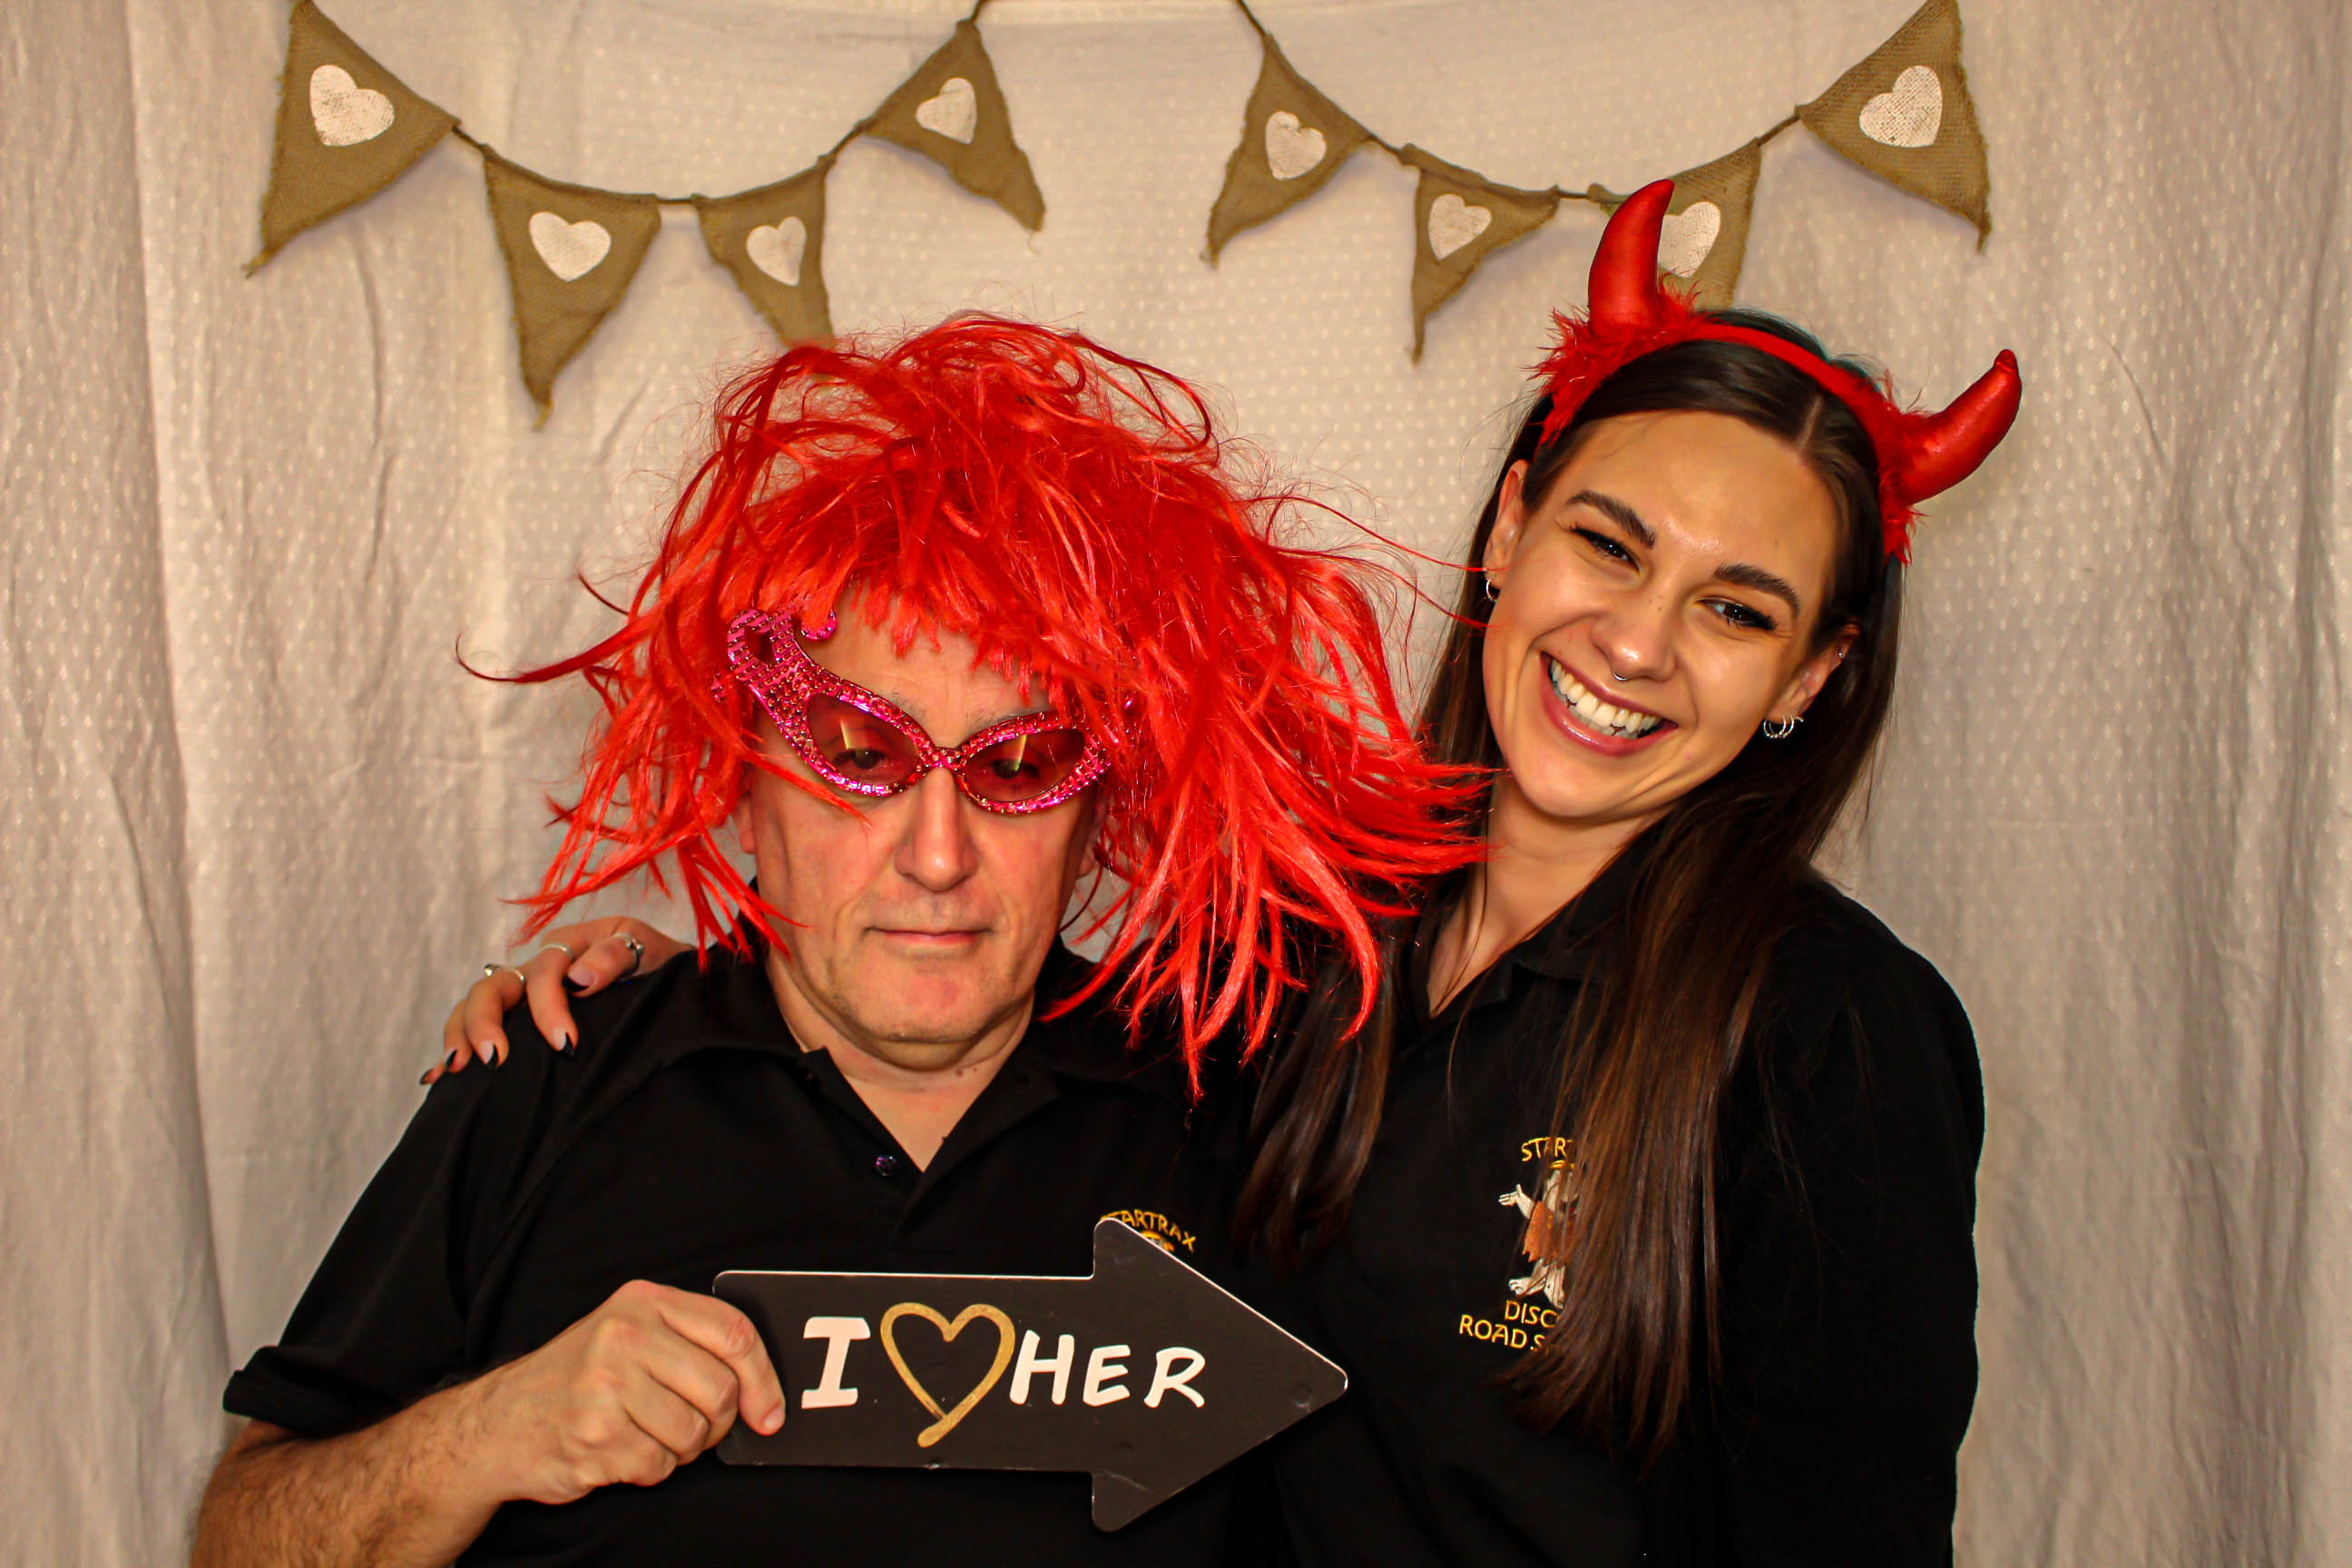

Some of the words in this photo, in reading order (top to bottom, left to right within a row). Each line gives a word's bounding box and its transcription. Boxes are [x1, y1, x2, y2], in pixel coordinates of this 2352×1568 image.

[1100, 1209, 1197, 1254] ARTRAX
[1459, 1314, 1549, 1356] ROADS
[1504, 1299, 1561, 1328] DISC
[801, 1316, 871, 1409] I
[1009, 1329, 1206, 1408] HER
